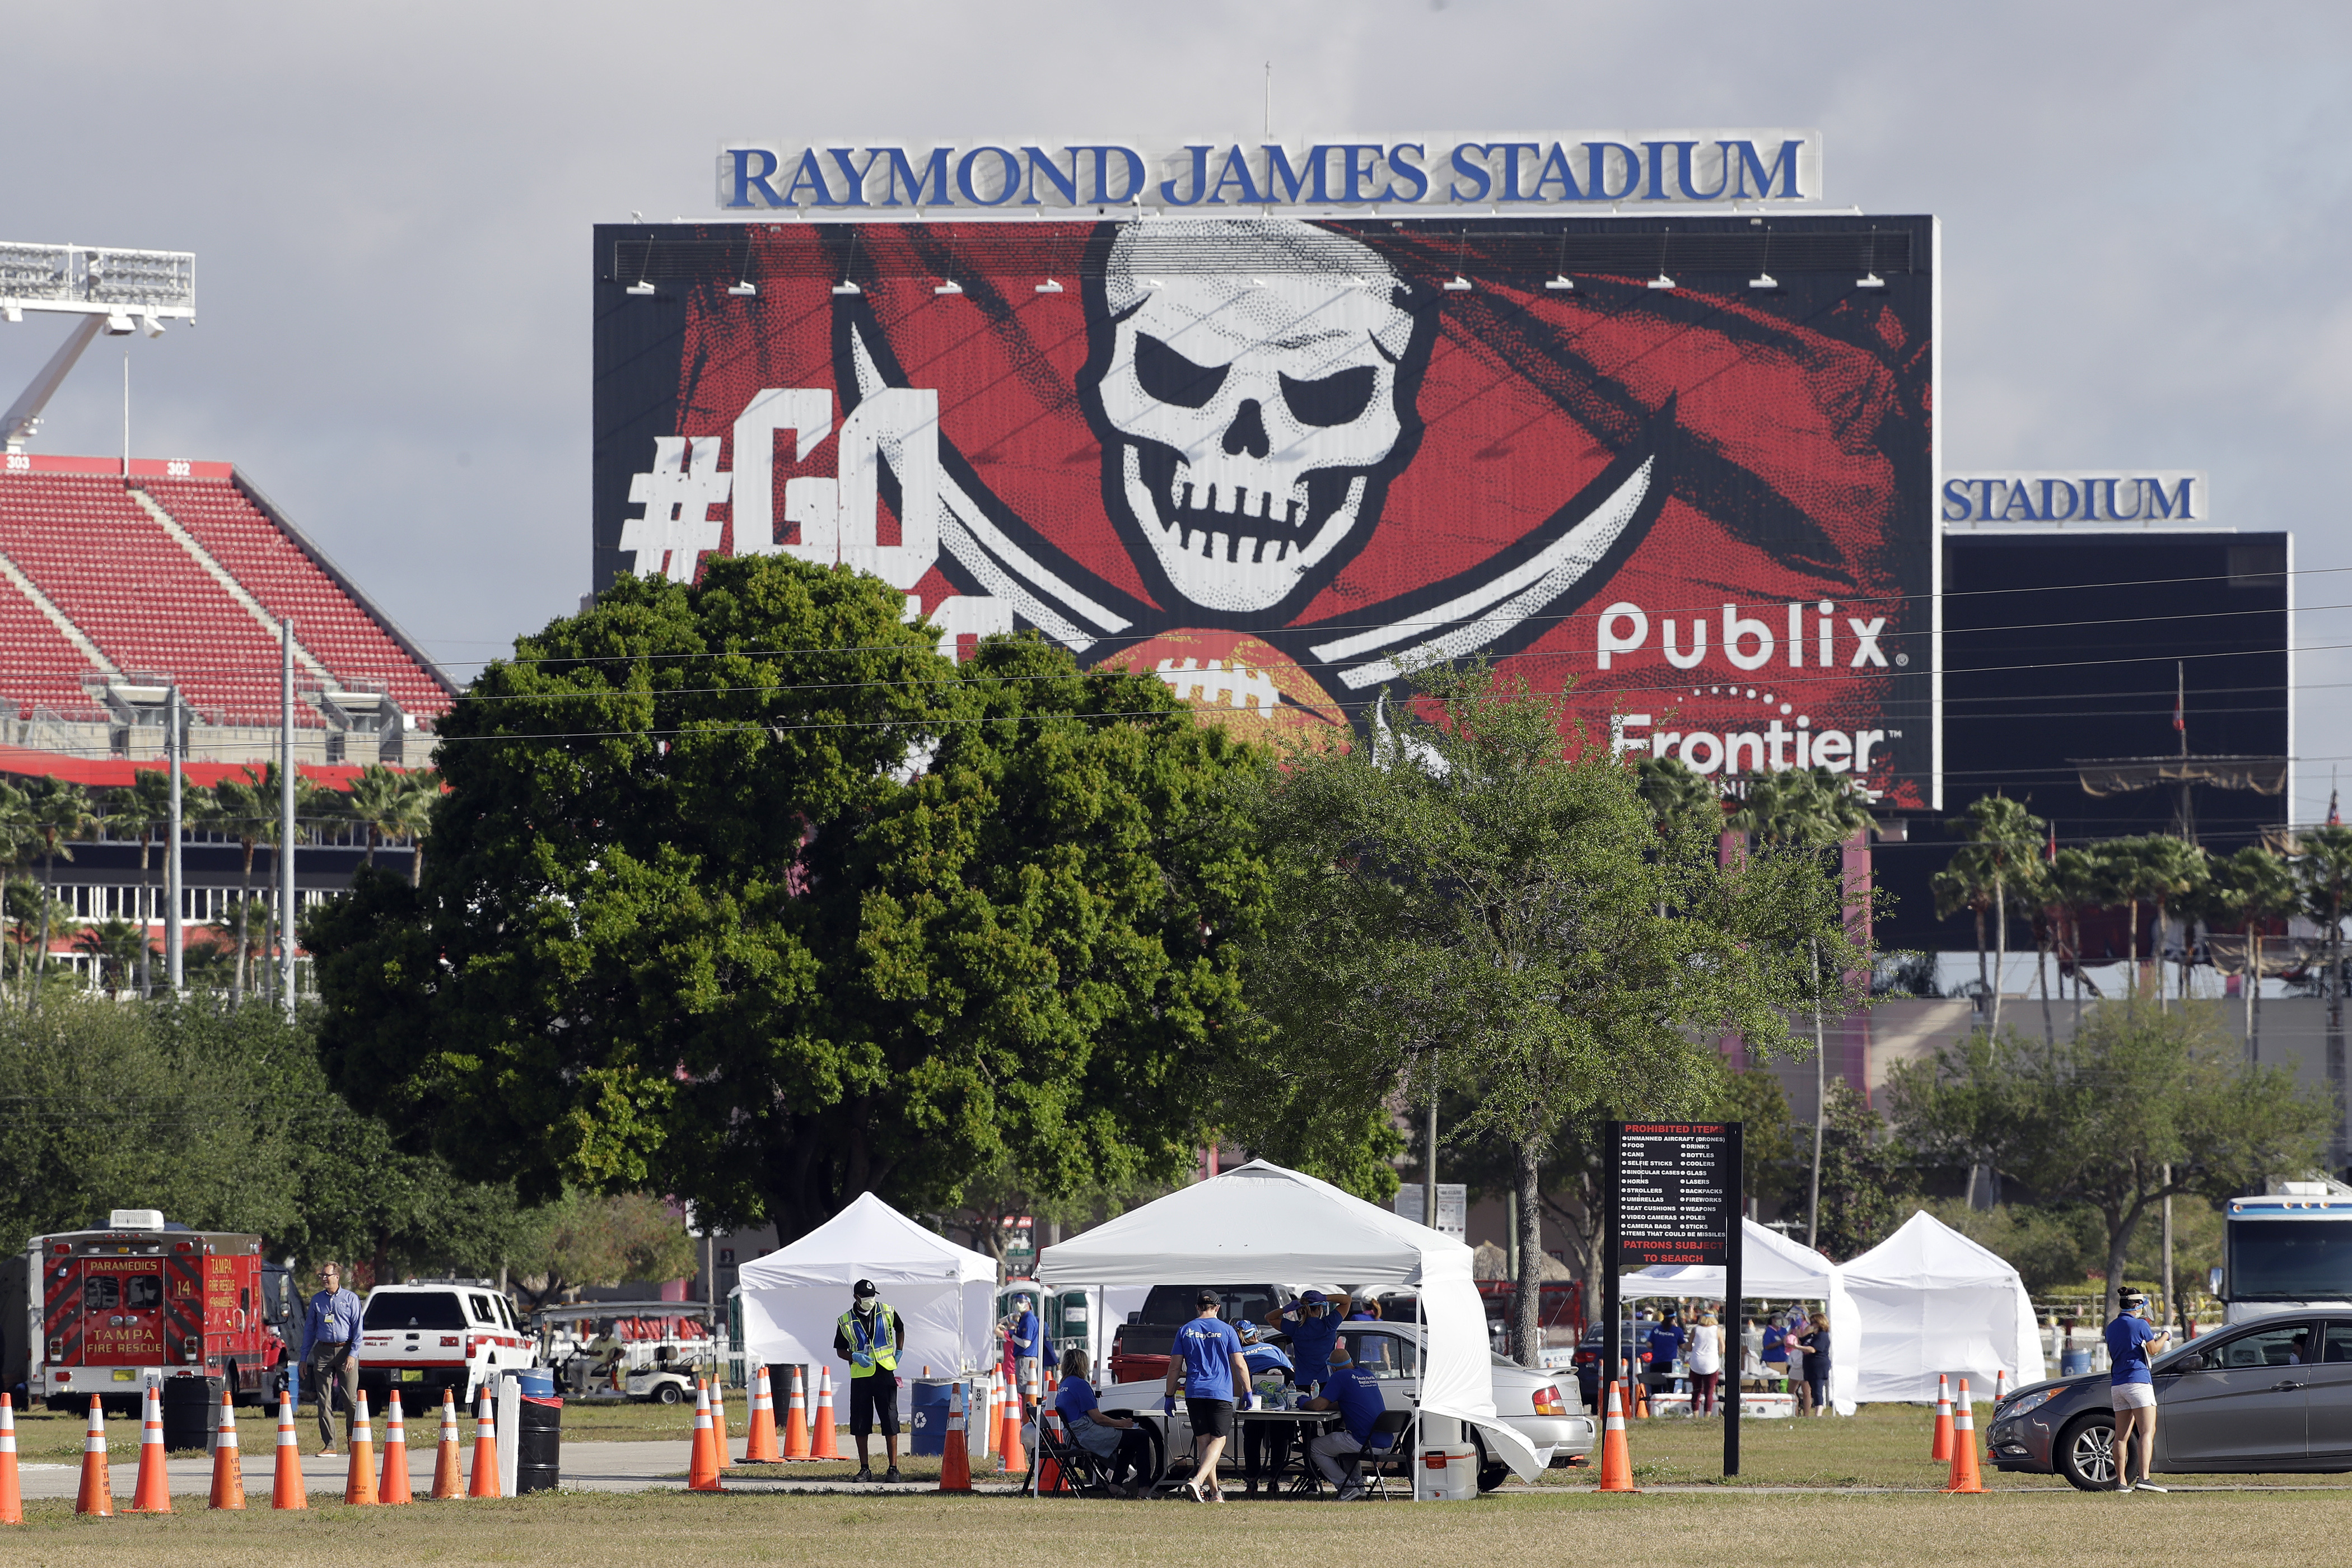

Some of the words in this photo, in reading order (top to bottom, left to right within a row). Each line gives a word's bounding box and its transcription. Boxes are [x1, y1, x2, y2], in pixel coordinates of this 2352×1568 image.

[726, 144, 1146, 207] RAYMOND
[1159, 142, 1429, 206] JAMES
[1450, 139, 1805, 203] STADIUM
[6, 456, 30, 470] 303
[167, 461, 190, 475] 302
[1943, 477, 2196, 521] STADIUM
[1597, 599, 1889, 671] Publix
[1611, 713, 1884, 776] Frontier
[1625, 1124, 1690, 1133] PROHIBITED
[1692, 1125, 1725, 1133] ITEMS
[1624, 1240, 1672, 1249] PATRONS
[1675, 1241, 1724, 1249] SUBJECT
[90, 1261, 157, 1271] PARAMEDICS
[210, 1258, 232, 1275] TAMPA
[177, 1280, 191, 1296] 14
[93, 1329, 155, 1340] TAMPA
[1195, 1331, 1222, 1340] BayCare
[87, 1343, 112, 1353] FIRE
[117, 1343, 162, 1352] RESCUE
[1245, 1346, 1273, 1356] BayCare
